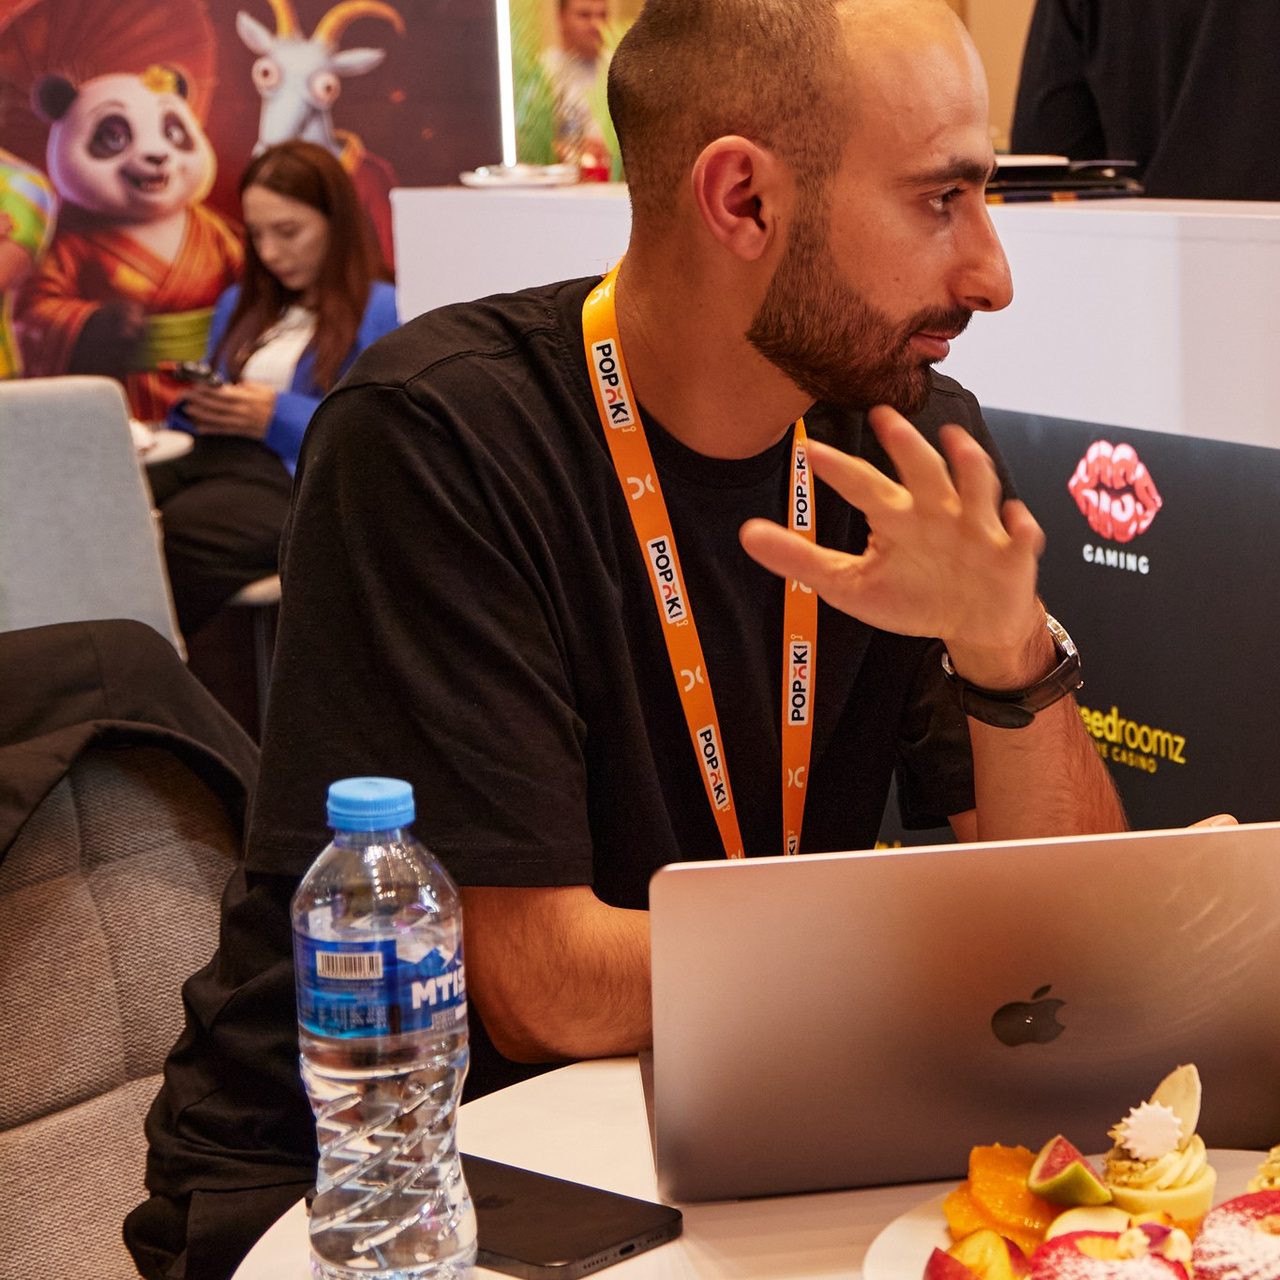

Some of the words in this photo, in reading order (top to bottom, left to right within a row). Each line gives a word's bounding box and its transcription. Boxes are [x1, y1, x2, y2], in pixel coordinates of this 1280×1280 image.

[1083, 544, 1149, 574] GAMING
[1080, 706, 1186, 764] eedroomz
[1111, 747, 1157, 773] CASINO
